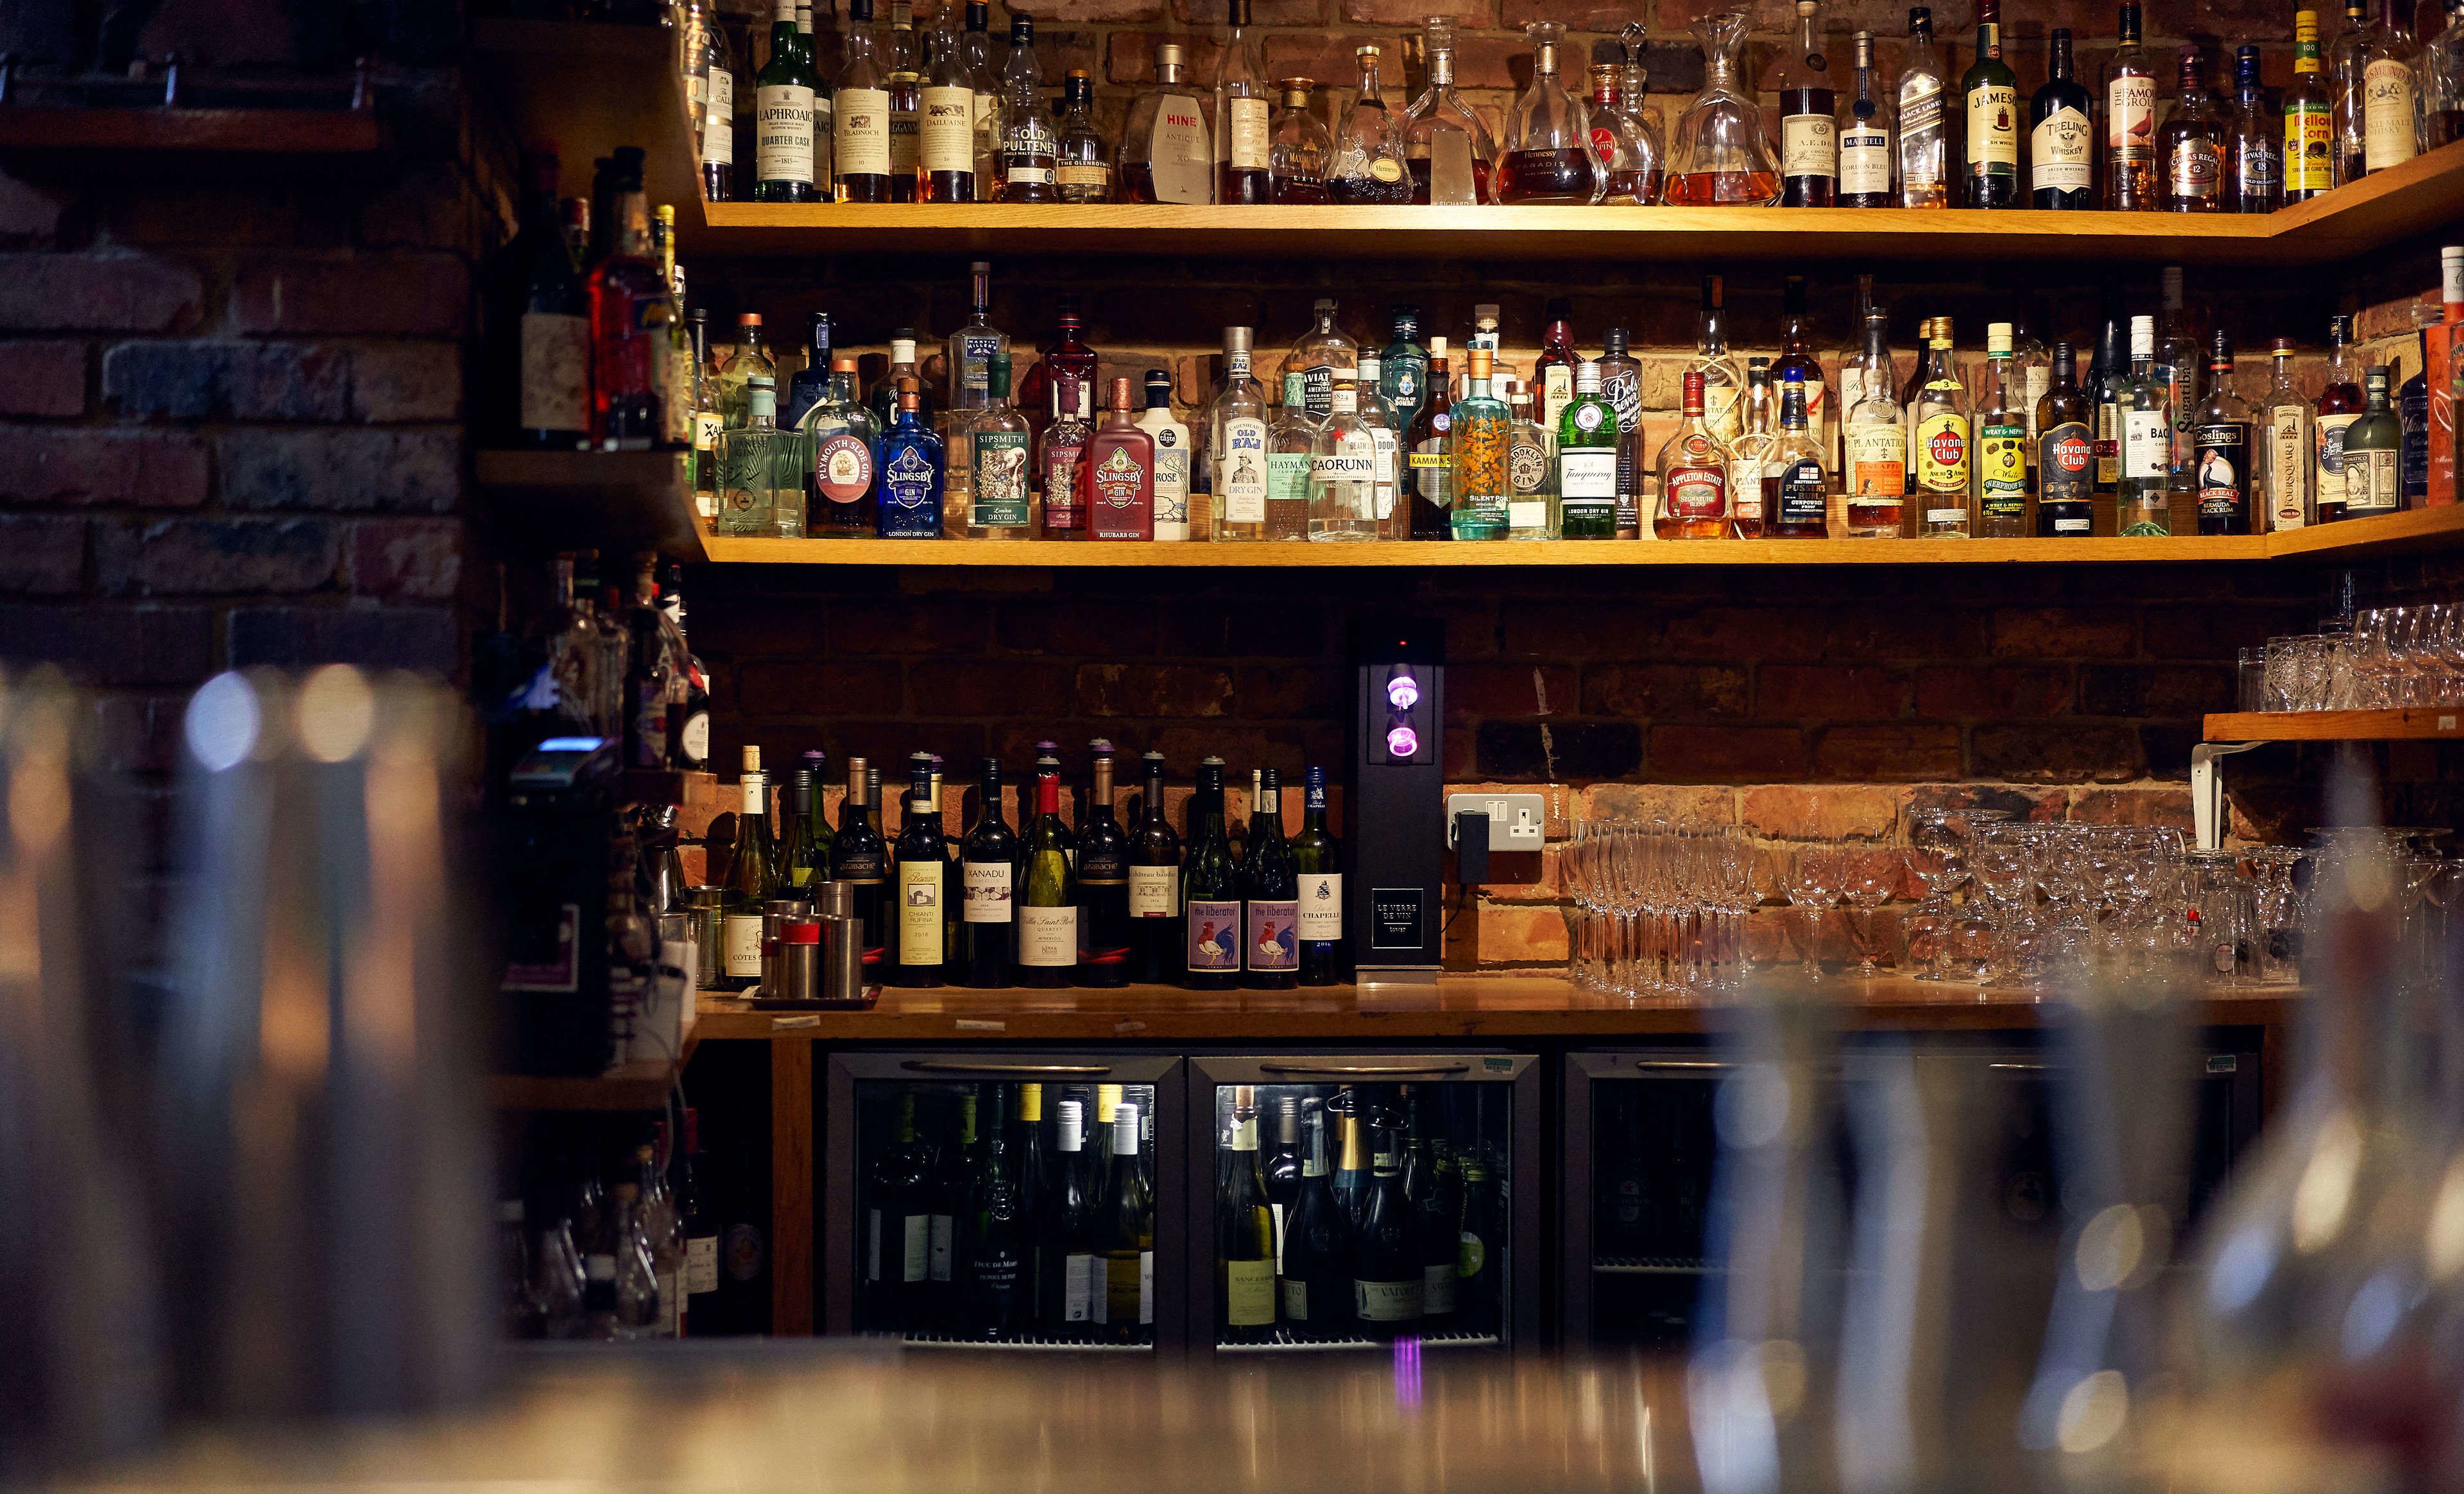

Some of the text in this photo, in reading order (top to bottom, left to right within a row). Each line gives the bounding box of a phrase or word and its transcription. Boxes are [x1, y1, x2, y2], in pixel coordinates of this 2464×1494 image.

[1974, 92, 2017, 108] JAMESO
[759, 108, 813, 123] LAPHROAIG
[1899, 108, 1921, 121] BLACK
[1167, 114, 1197, 127] HINE
[1020, 129, 1046, 140] OLD
[2046, 121, 2087, 137] TEELING
[762, 136, 810, 148] QUARTER CASK
[1166, 133, 1201, 143] ANTIQUE
[1845, 137, 1884, 146] MARTELL
[1004, 140, 1056, 153] PULTENEY
[2051, 146, 2083, 155] WHISKEY
[1525, 150, 1557, 159] Hennessy
[2198, 153, 2220, 166] REGAL
[1376, 164, 1398, 173] Hennessy
[1516, 161, 1566, 170] PARADIS
[1842, 163, 1870, 171] CORDON
[2193, 165, 2201, 173] 12
[2257, 162, 2266, 171] 18
[1304, 373, 1330, 383] AVIAT
[1607, 379, 1638, 405] Bols
[2177, 367, 2194, 434] Sagatiba
[1229, 424, 1263, 432] CADENHEAD'S
[2196, 429, 2237, 443] Goslings
[1926, 436, 1965, 449] Havana
[1935, 449, 1959, 460] Club
[2053, 443, 2091, 455] Havana
[819, 439, 869, 482] PLYMOUTH SLOE GIN
[1270, 461, 1310, 469] HAYMAN
[2062, 454, 2085, 465] Club
[1312, 459, 1372, 472] CAORUNN
[887, 469, 934, 483] SLINGSBY
[1097, 469, 1144, 483] SLINGSBY
[1156, 473, 1177, 482] ROSE
[1566, 468, 1611, 480] Tanqueray
[1672, 472, 1722, 486] APPLETON ESTATE
[1946, 470, 1953, 479] 3
[1993, 468, 2022, 479] White
[2284, 442, 2295, 507] FOURSQUARE
[1514, 476, 1535, 485] GIN
[1985, 481, 2018, 490] OVERPROOF
[2070, 481, 2079, 494] 7
[2200, 490, 2217, 499] BLACK
[1195, 905, 1235, 916] the liberator
[1255, 905, 1295, 916] the liberator
[1037, 916, 1059, 925] Saint
[1059, 916, 1075, 925] Roch
[733, 953, 757, 961] CÔTES
